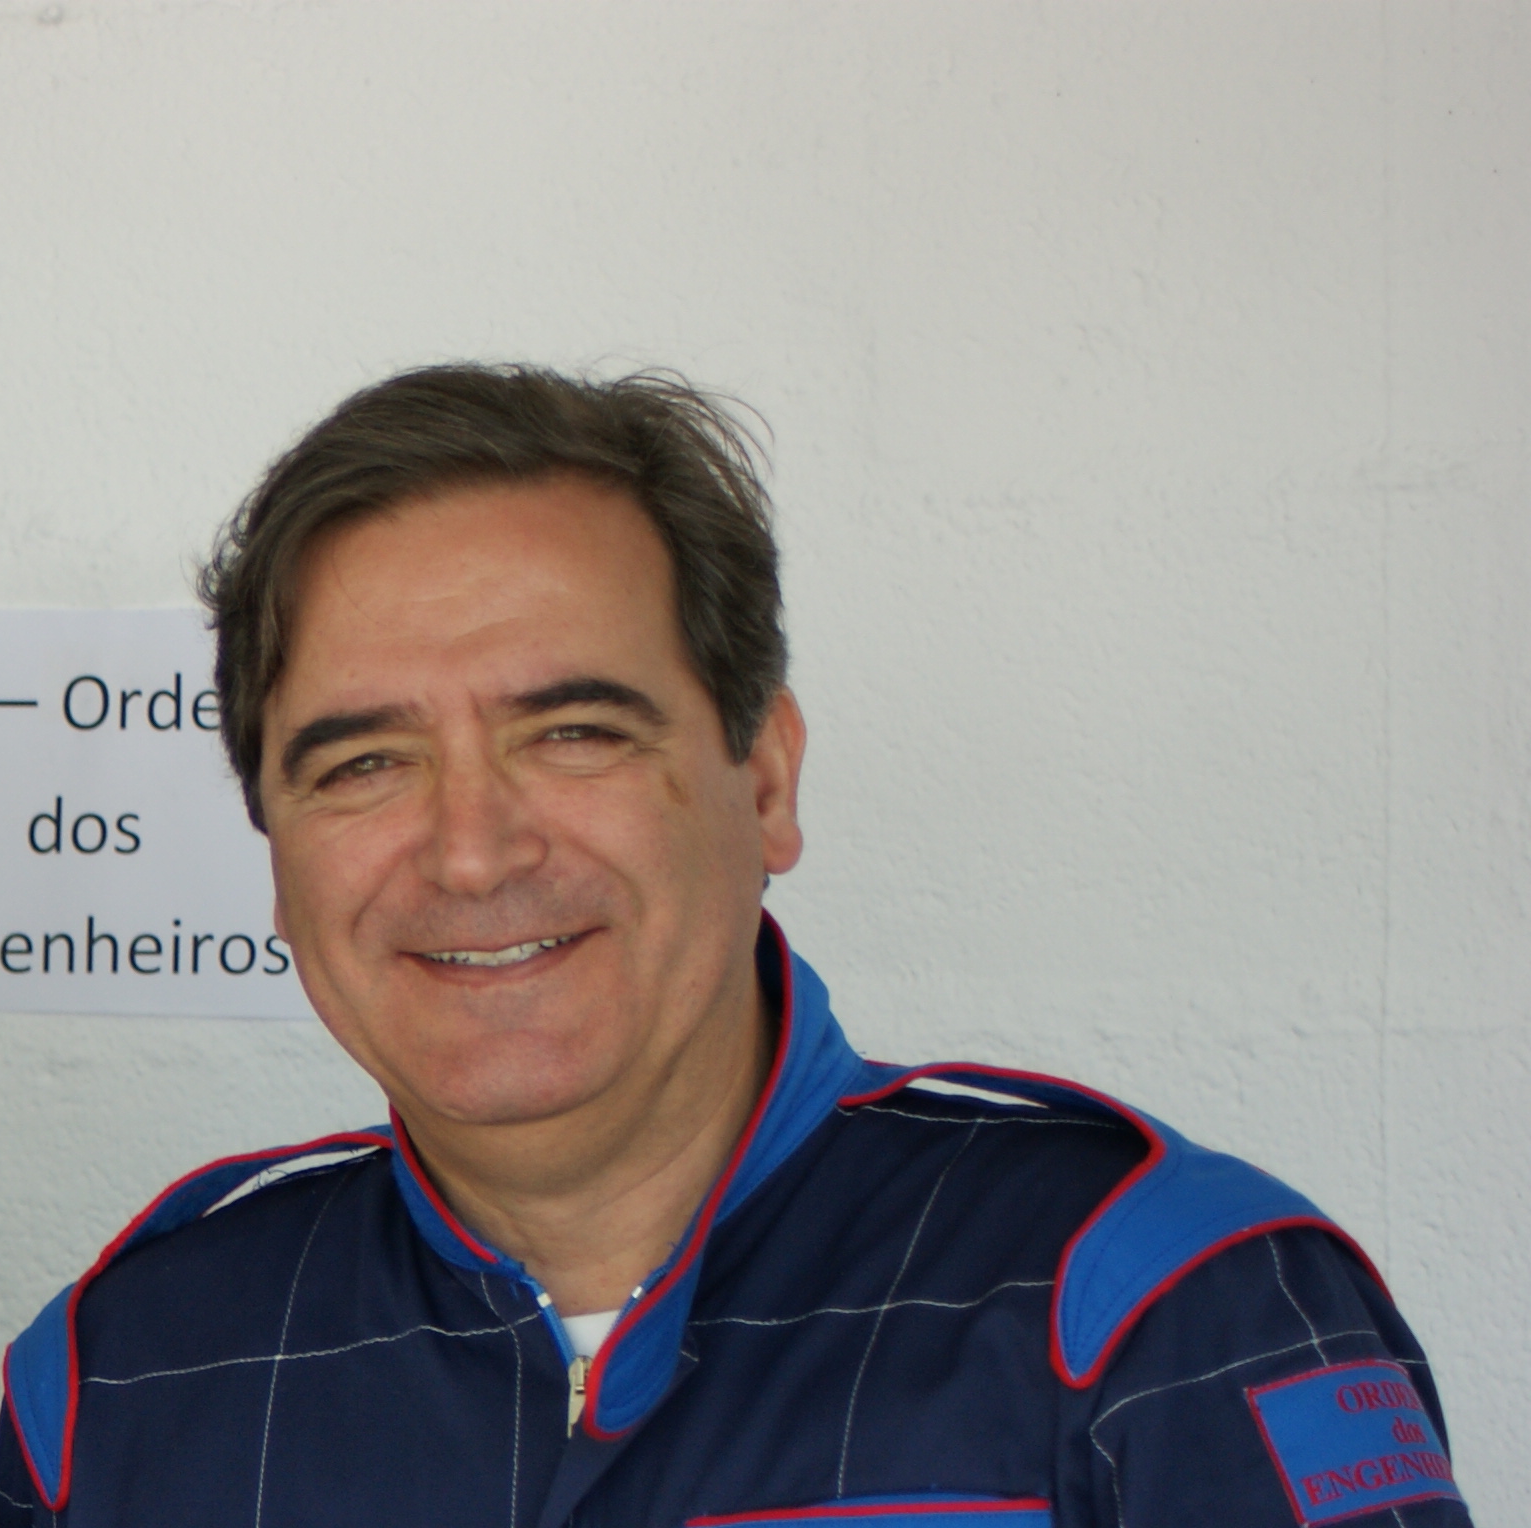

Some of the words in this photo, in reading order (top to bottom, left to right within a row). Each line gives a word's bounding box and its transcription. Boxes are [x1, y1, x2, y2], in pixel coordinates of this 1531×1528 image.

[62, 672, 222, 732] Orde
[27, 796, 142, 855] dos
[1335, 1380, 1424, 1414] ORDE
